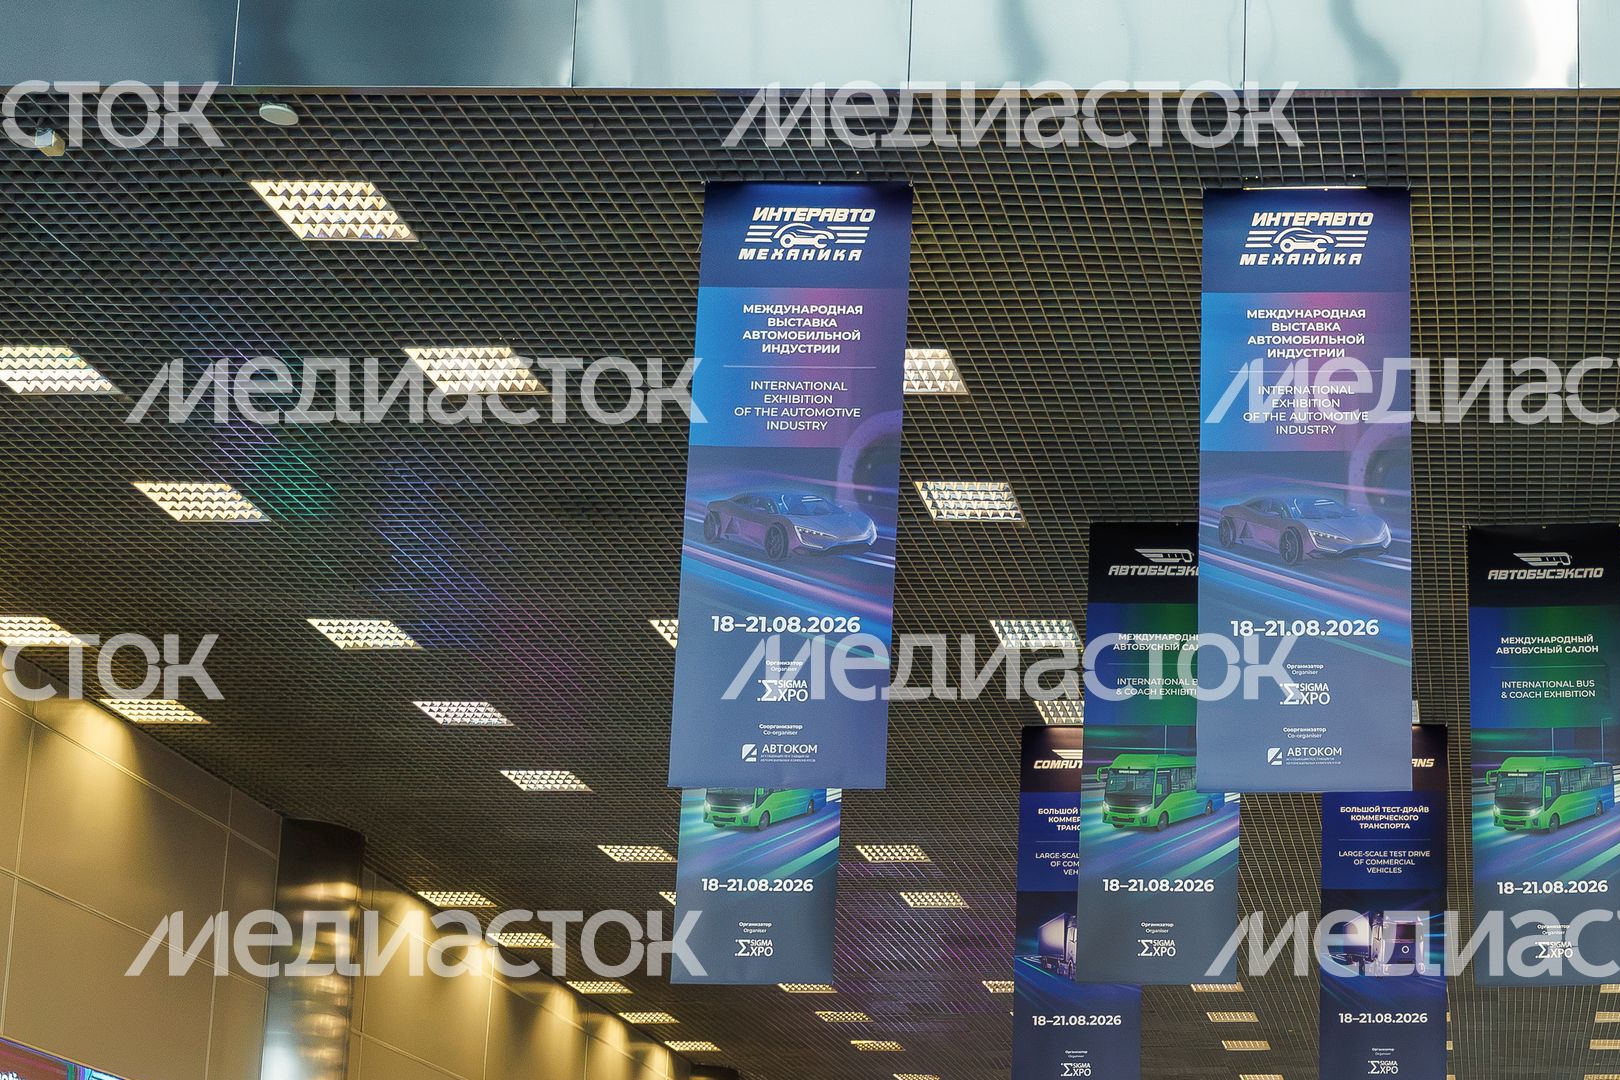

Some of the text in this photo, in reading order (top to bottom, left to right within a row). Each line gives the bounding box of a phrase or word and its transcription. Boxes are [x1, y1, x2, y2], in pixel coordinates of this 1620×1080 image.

[753, 207, 876, 223] ИНТЕРАВТО
[1252, 212, 1374, 227] ИНТЕРАВТО
[738, 249, 862, 262] МЕХАНИКА
[1240, 253, 1362, 265] МЕХАНИКА
[743, 305, 863, 316] МЕЖДУНАРОДНАЯ
[1247, 310, 1366, 320] МЕЖДУНАРОДНАЯ
[768, 318, 837, 327] ВЫСТАВКА
[743, 329, 861, 341] АВТОМОБИЛЬНОЙ
[1248, 334, 1365, 345] АВТОМОБИЛЬНОЙ
[762, 344, 840, 354] ИНДУСТРИИ
[751, 381, 848, 391] INTERNATIONAL
[764, 395, 833, 404] EXHIBITION
[734, 407, 861, 417] OF THE AUTOMOTIVE
[767, 421, 828, 430] INDUSTRY
[1488, 568, 1604, 580] АВТОБУСЭКСПО
[1501, 634, 1593, 645] МЕЖДУНАРОДНЫЙ
[1496, 644, 1598, 655] АВТОБУСНЫЙ САЛОН
[778, 680, 808, 689] SIGMA
[1502, 680, 1594, 688] INTERNATIONAL BUS
[1544, 690, 1595, 698] EXHIBITION
[762, 744, 817, 754] АВТОКОМ
[1340, 805, 1429, 814] БОЛЬШОЙ ТЕСТ-ДРАЙВ
[1359, 822, 1410, 830] ТРАНСПОРТА
